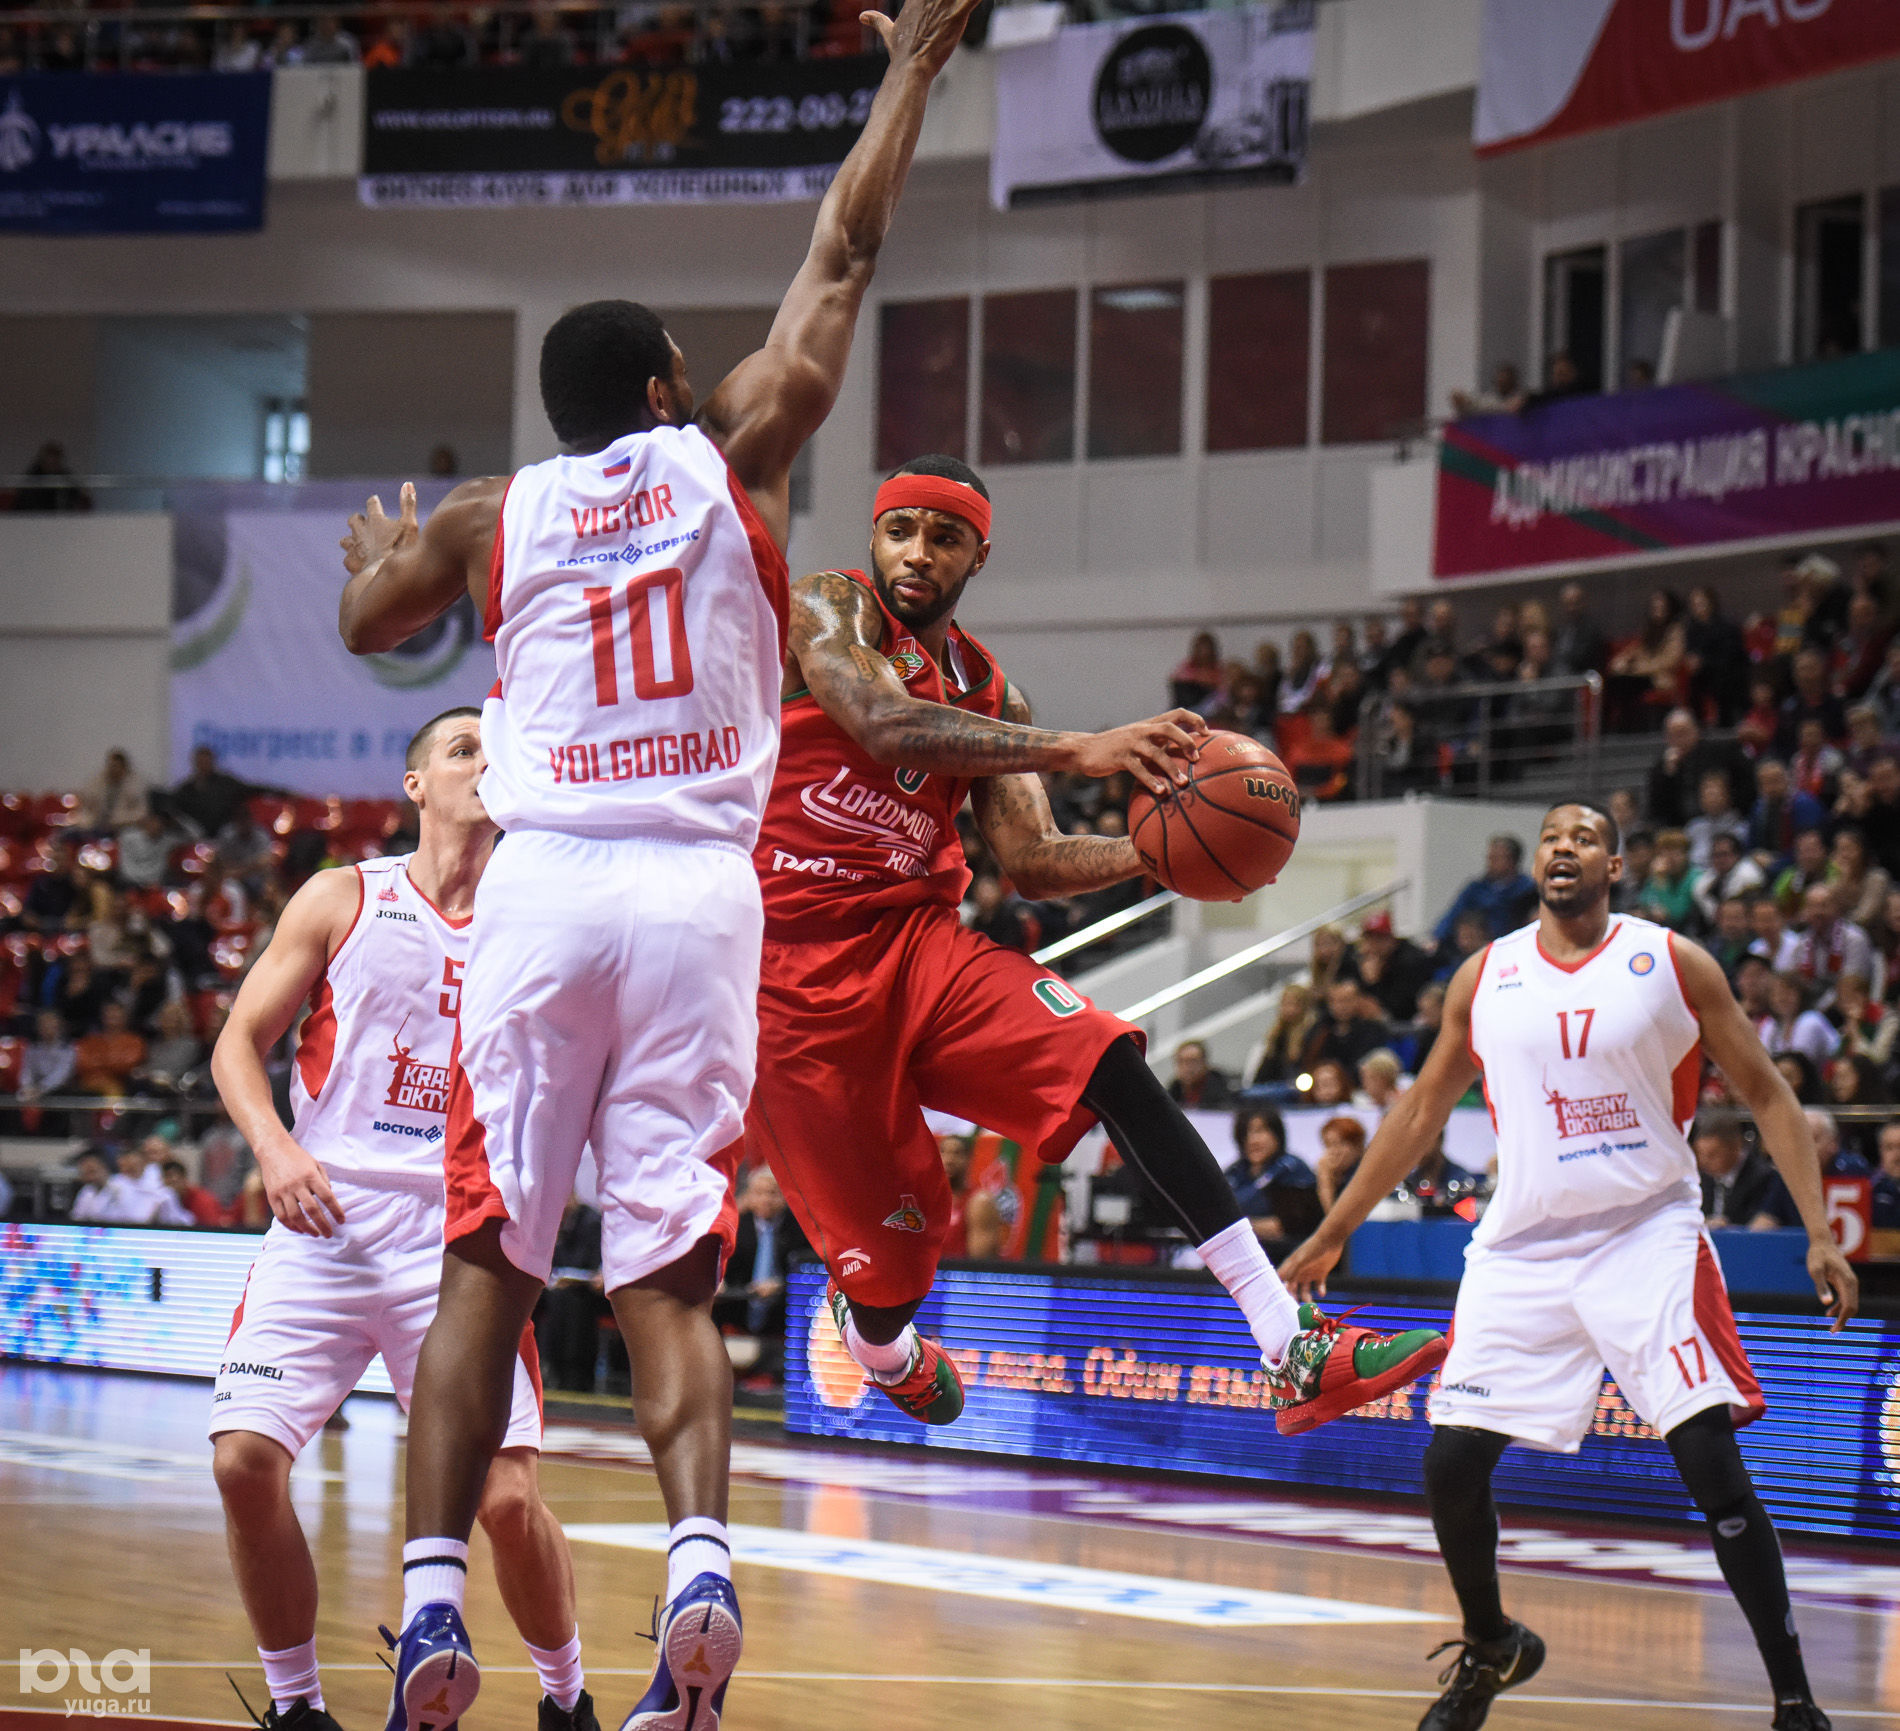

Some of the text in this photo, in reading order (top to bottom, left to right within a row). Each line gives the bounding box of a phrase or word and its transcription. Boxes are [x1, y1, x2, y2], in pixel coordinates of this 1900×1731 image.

[570, 483, 677, 539] VICTOR
[556, 529, 701, 568] ВОСТОК СЕРВИС
[582, 567, 694, 708] 10
[549, 725, 741, 785] VOLGOGRAD
[1242, 776, 1300, 819] lson
[1031, 977, 1087, 1018] 0
[1556, 1008, 1596, 1060] 17
[1561, 1094, 1627, 1120] KRASNY
[1564, 1110, 1638, 1137] OKTYABR
[373, 1121, 424, 1138] ВОСТОК
[1826, 1183, 1866, 1258] 5
[842, 1259, 863, 1278] ANTA
[228, 1361, 284, 1382] DANIELI
[1669, 1335, 1708, 1390] 17
